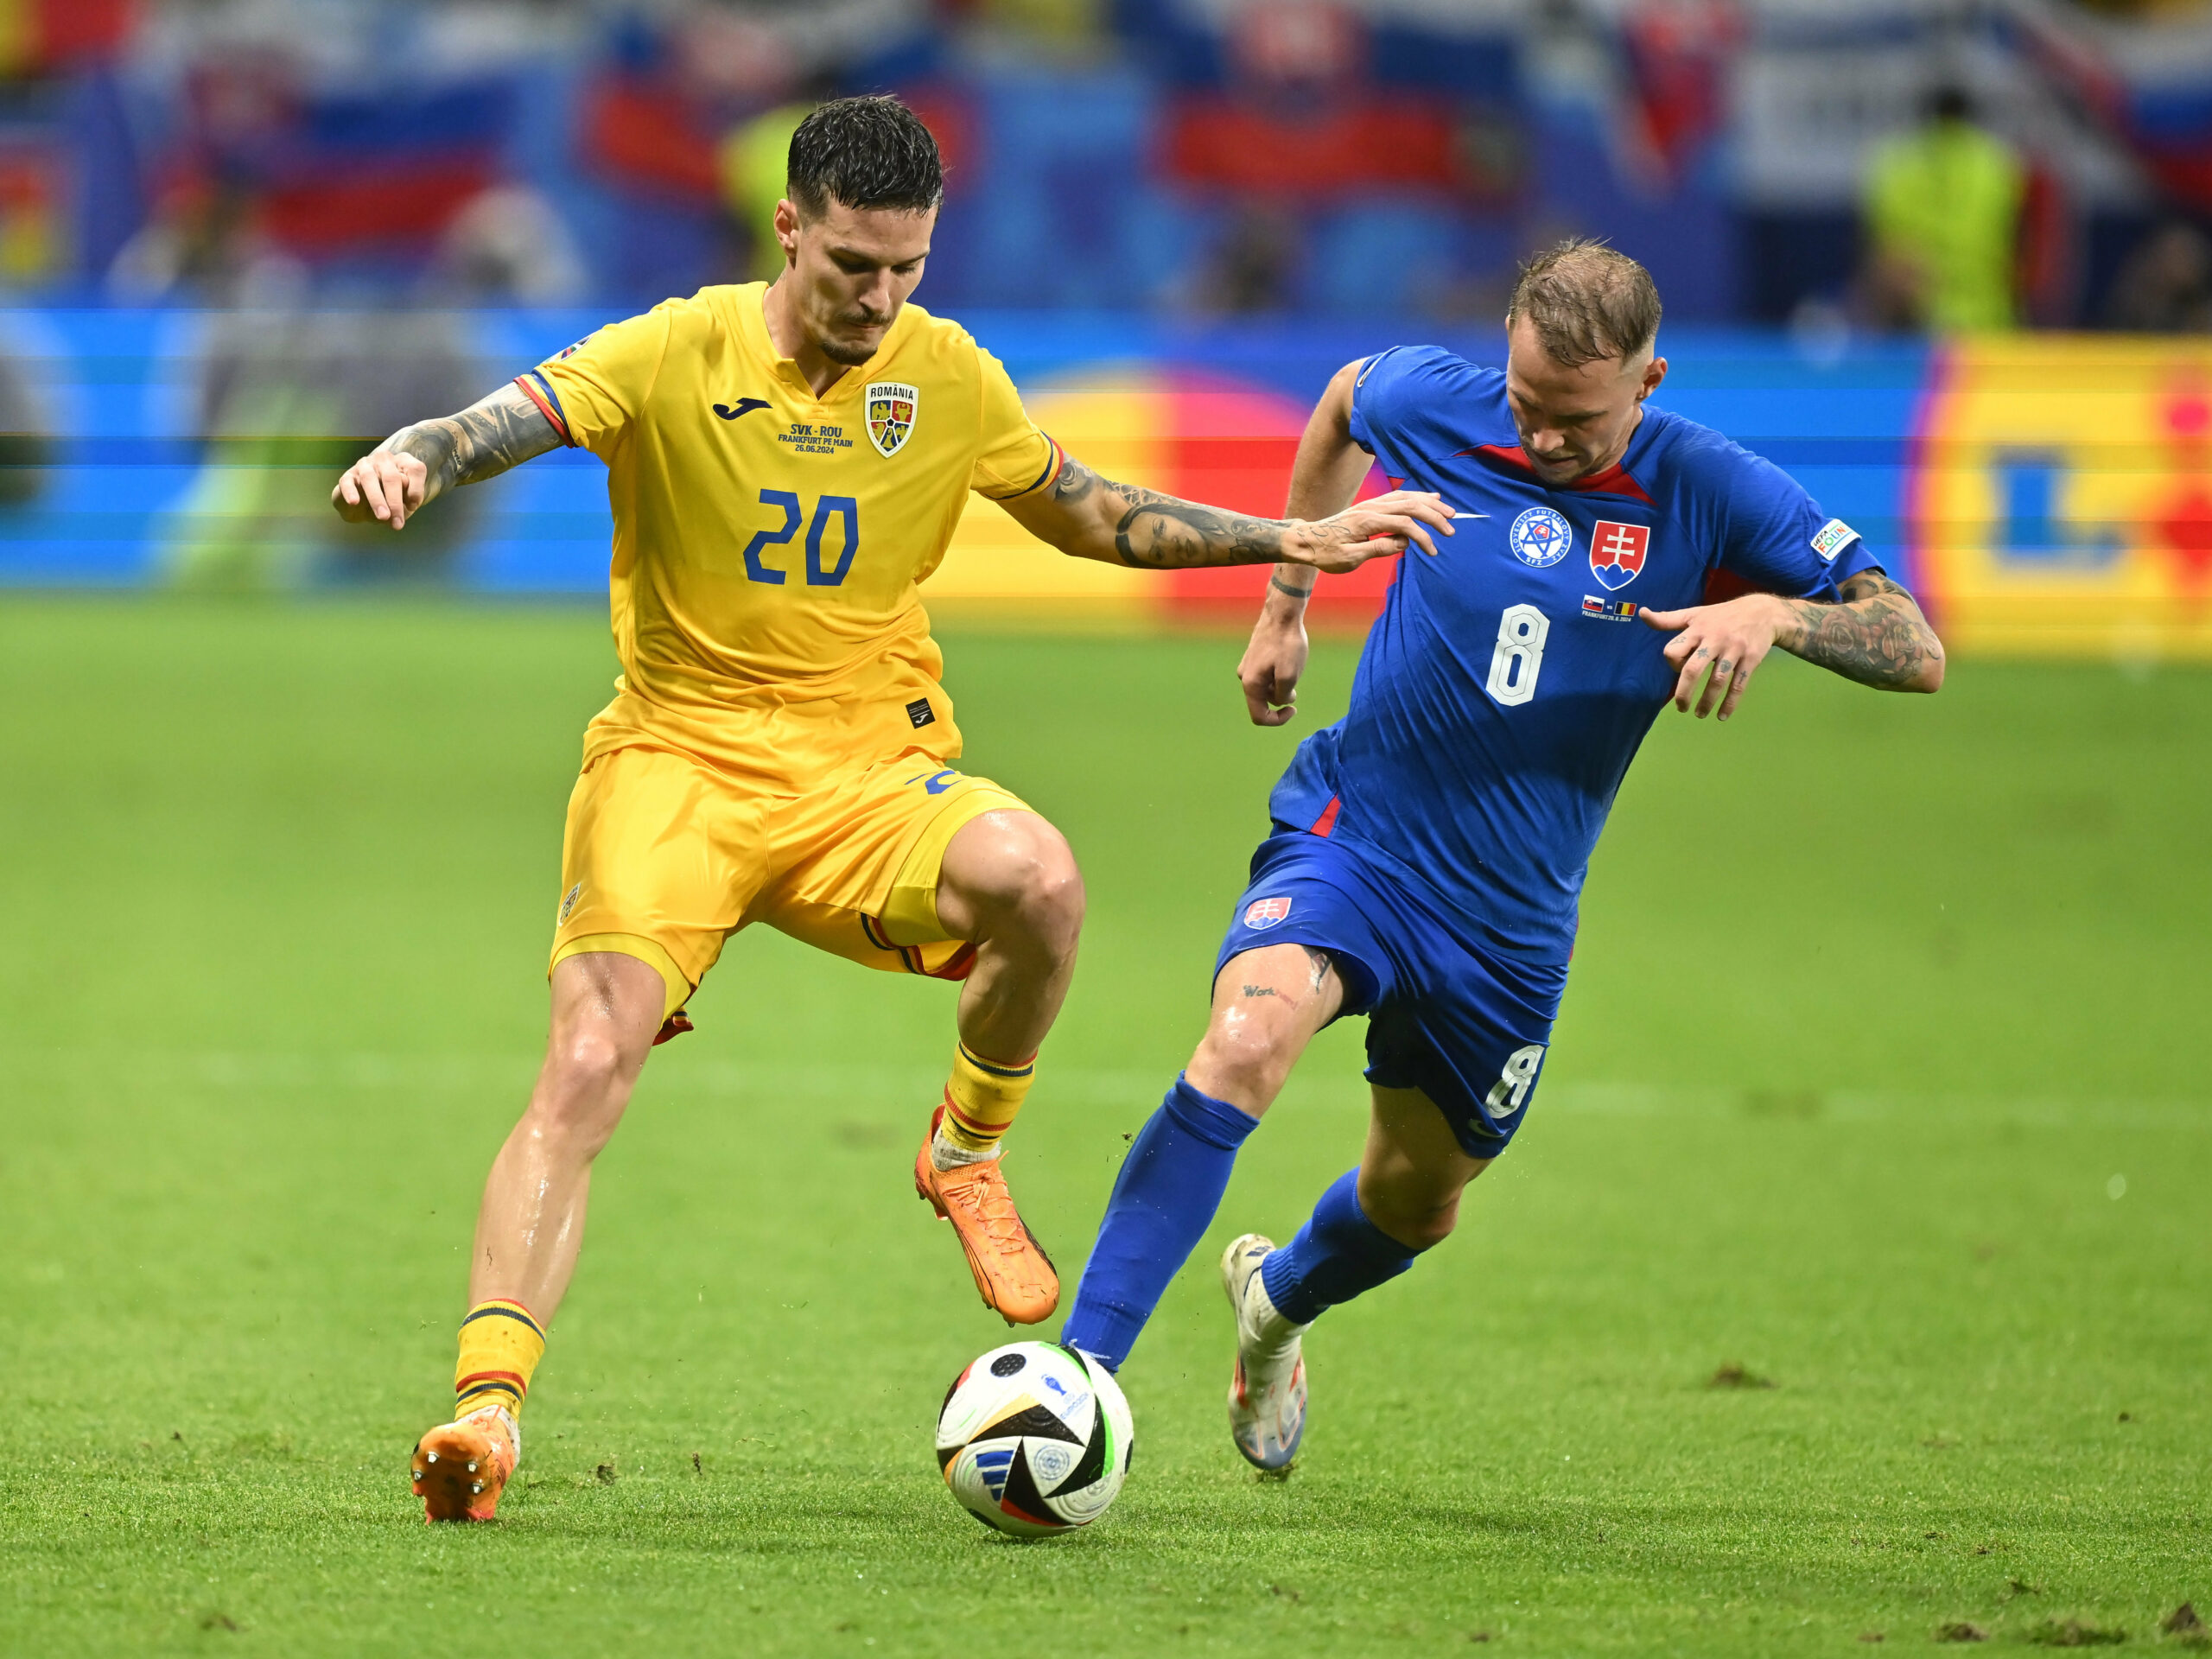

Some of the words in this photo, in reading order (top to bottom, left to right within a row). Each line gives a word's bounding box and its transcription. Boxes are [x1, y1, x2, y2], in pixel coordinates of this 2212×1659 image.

[791, 424, 812, 435] SVK
[819, 426, 842, 437] ROU
[778, 434, 822, 445] FRANKFURT
[833, 439, 853, 448] MAIN
[795, 444, 834, 454] 26.06.2024
[743, 488, 859, 586] 20
[1818, 526, 1847, 553] FOUN
[1526, 557, 1542, 566] SFZ
[1485, 603, 1550, 707] 8
[1484, 1045, 1546, 1119] 8
